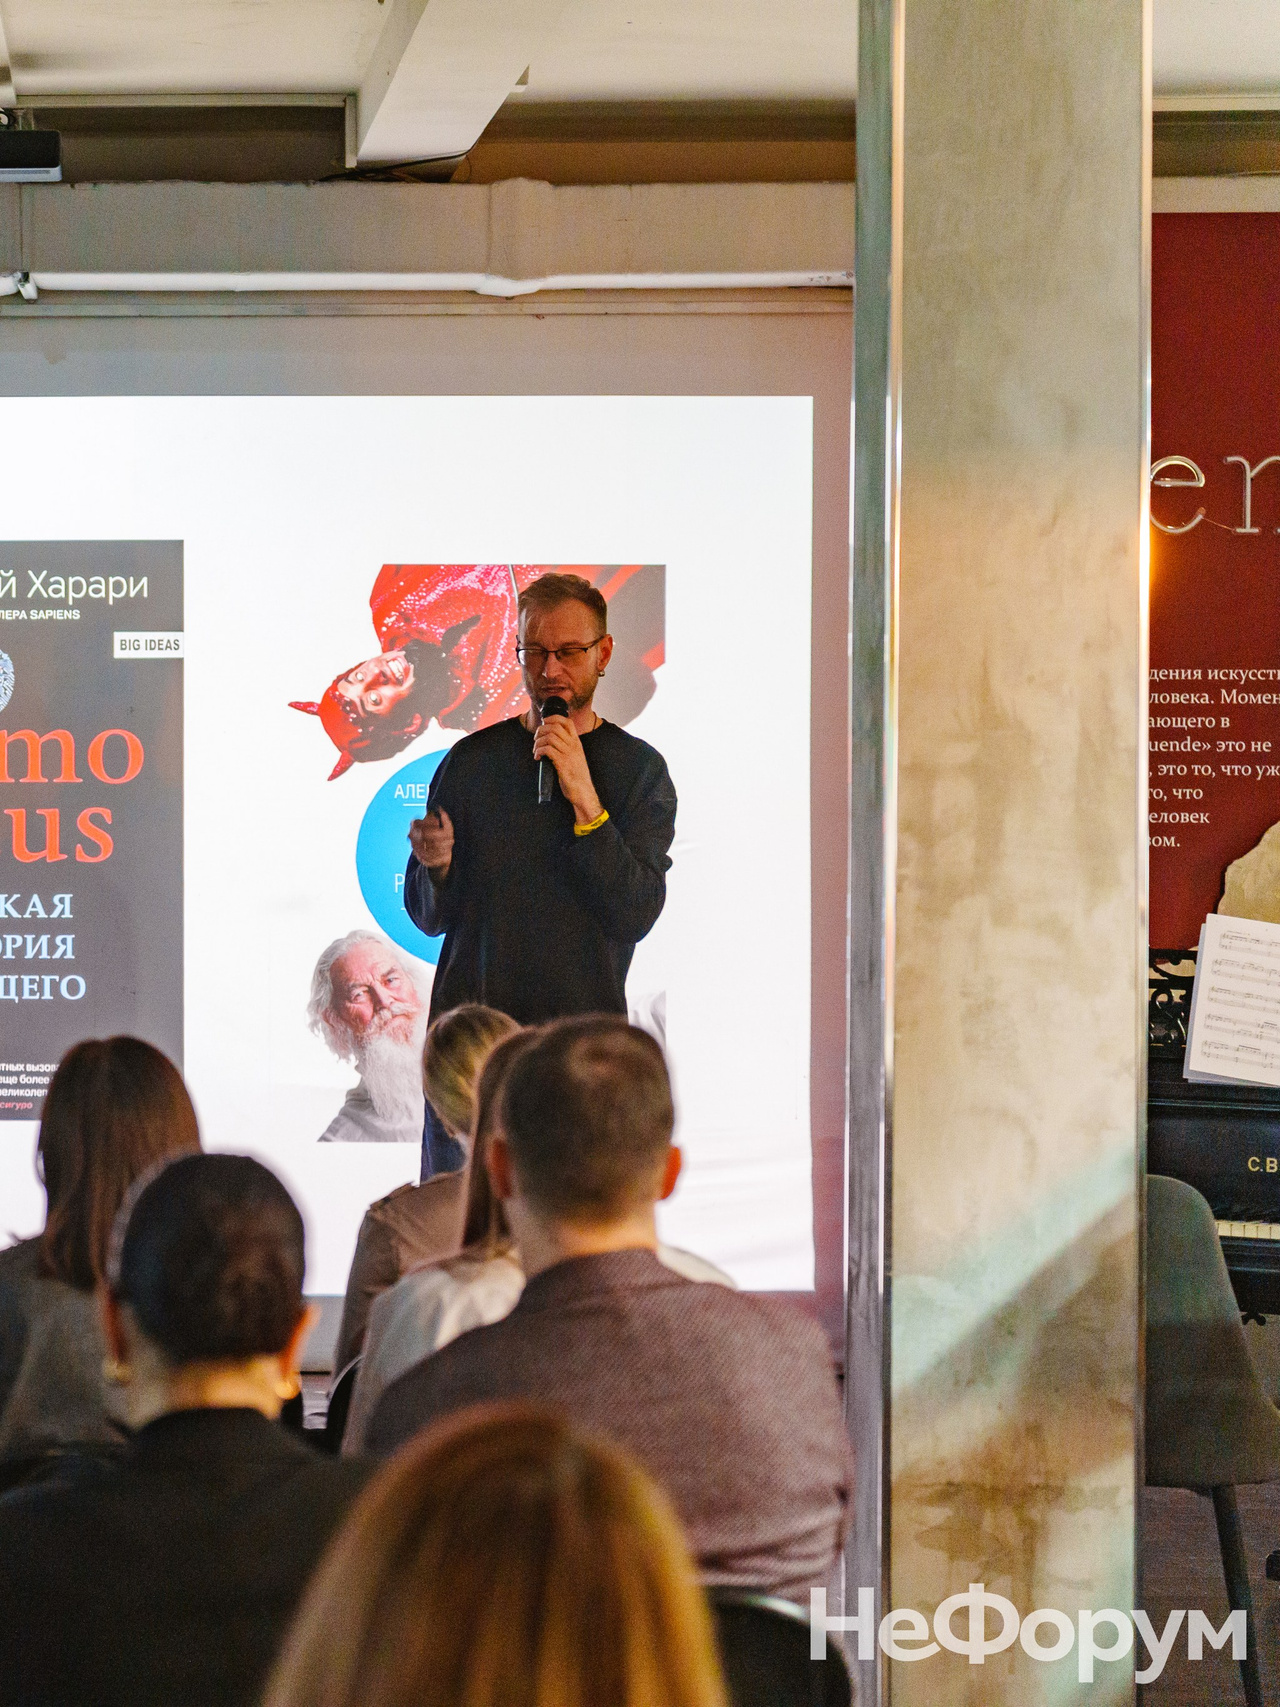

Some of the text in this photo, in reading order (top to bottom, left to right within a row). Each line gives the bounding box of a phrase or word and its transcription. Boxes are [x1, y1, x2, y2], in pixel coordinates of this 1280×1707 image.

[1150, 455, 1280, 533] en
[27, 570, 148, 606] Харари
[29, 609, 81, 620] SAPIENS
[119, 638, 180, 652] BIG IDEAS
[1149, 668, 1203, 682] дения
[1149, 688, 1280, 704] ловека. Момен
[1149, 716, 1231, 730] ающего в
[1149, 736, 1272, 752] uende» это не
[1157, 764, 1188, 776] это
[1191, 764, 1216, 778] то,
[1221, 764, 1252, 776] что
[1255, 764, 1280, 780] уж
[394, 783, 430, 799] АЛЕ
[1172, 788, 1204, 800] что
[1149, 812, 1210, 824] еловек
[394, 873, 406, 893] Р
[26, 1063, 59, 1073] вызов
[19, 1074, 51, 1085] более
[1247, 1156, 1279, 1173] C.B
